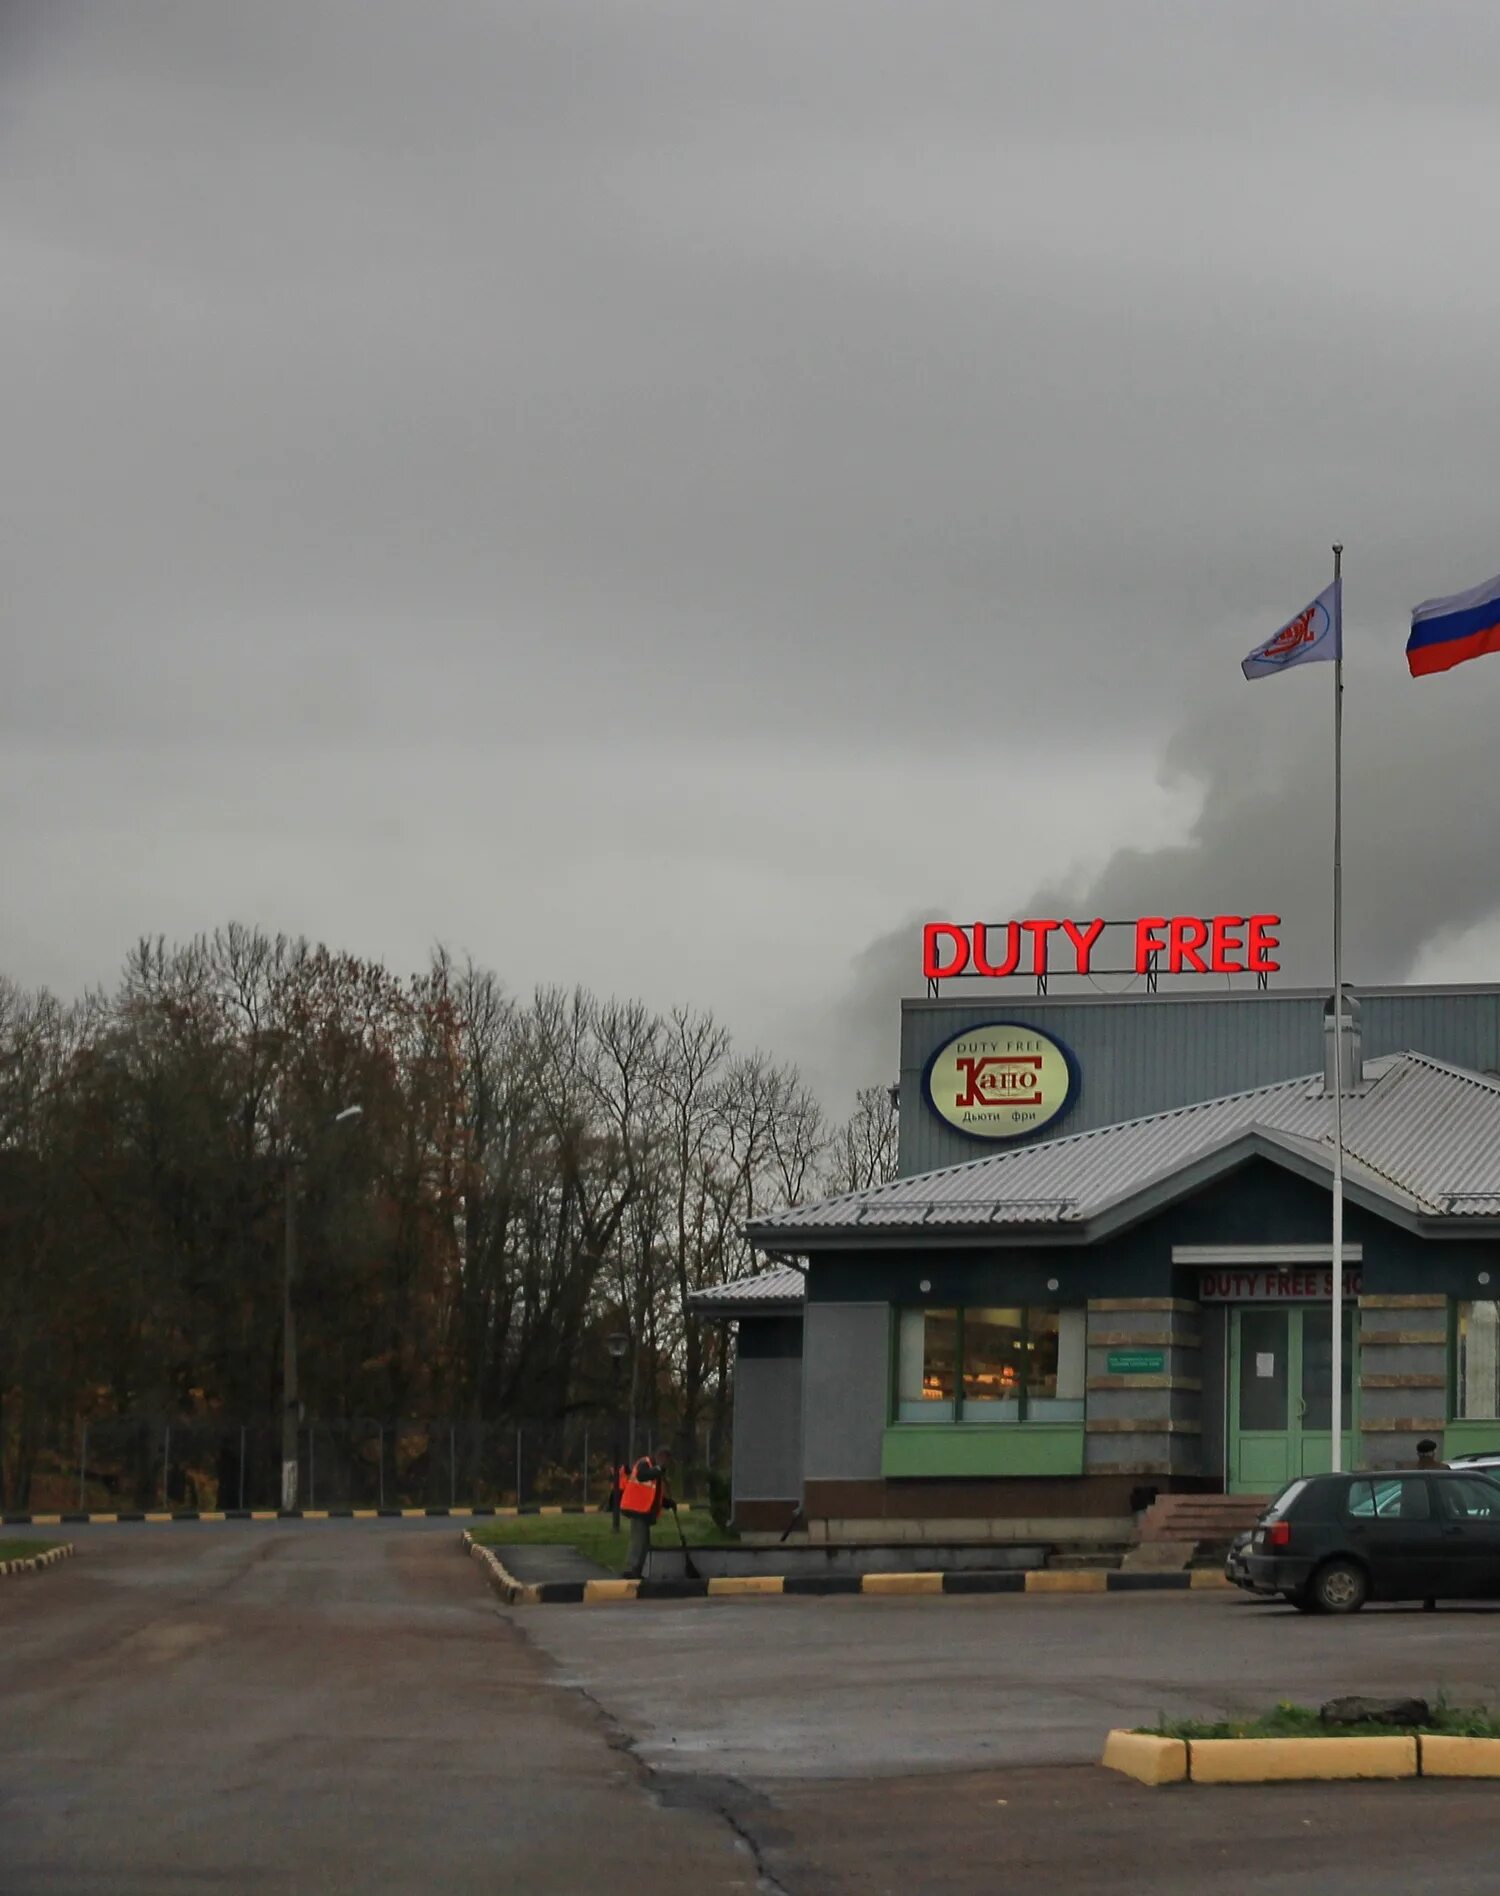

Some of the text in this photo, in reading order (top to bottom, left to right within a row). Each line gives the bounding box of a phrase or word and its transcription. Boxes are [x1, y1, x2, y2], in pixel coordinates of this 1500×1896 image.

[923, 914, 1281, 978] DUTY FREE
[957, 1040, 1042, 1054] DUTY FREE
[963, 1111, 1036, 1123] Дьюти фри
[1204, 1272, 1259, 1297] DUTY
[1265, 1271, 1317, 1297] FREE
